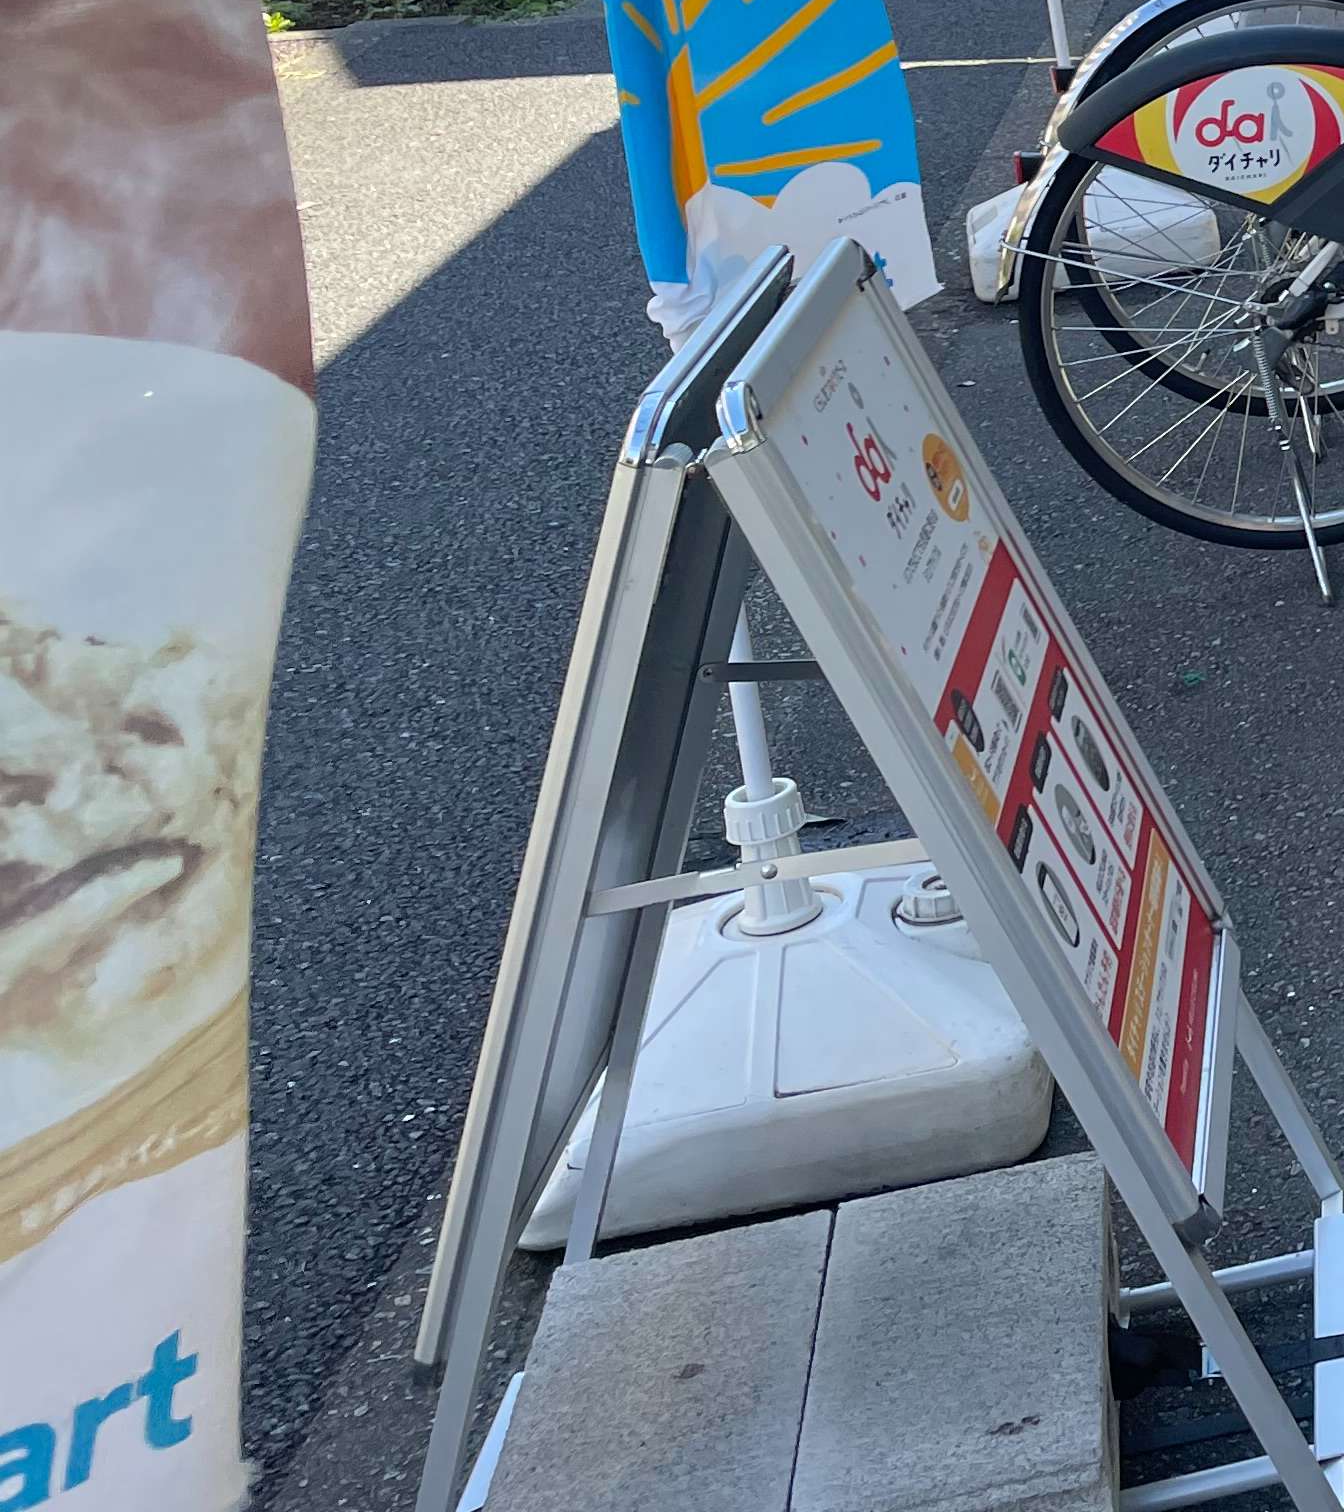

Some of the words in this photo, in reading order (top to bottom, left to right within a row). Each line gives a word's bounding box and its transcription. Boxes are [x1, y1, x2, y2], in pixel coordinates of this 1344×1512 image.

[1208, 148, 1281, 173] ダイチャリ
